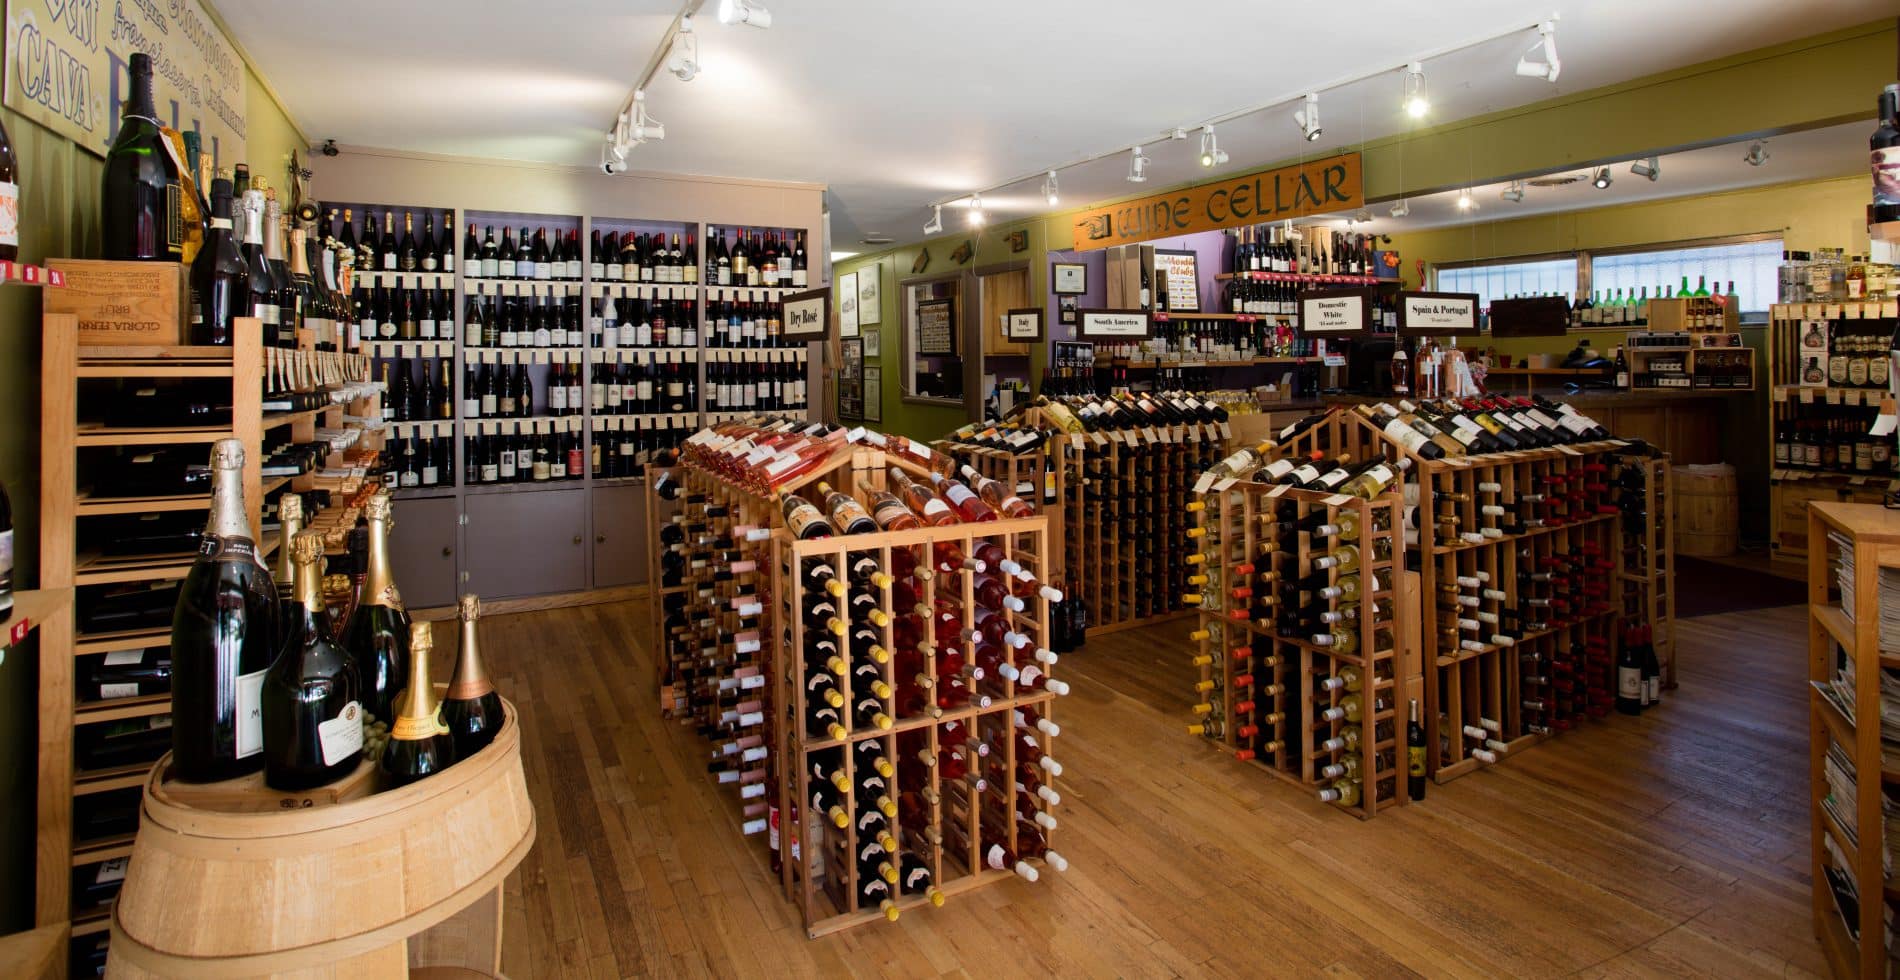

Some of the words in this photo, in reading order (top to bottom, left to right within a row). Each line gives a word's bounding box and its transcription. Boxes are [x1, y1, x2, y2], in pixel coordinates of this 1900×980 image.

[17, 23, 94, 132] CAVA
[1117, 197, 1191, 238] WINE
[1206, 164, 1353, 223] CELLAR
[98, 304, 130, 314] BRUT
[1318, 301, 1347, 309] Domestic
[1412, 304, 1431, 316] Spain
[1433, 305, 1439, 314] &
[1441, 304, 1468, 316] Portugal
[790, 311, 801, 328] Dry
[802, 308, 818, 324] Rosé
[1018, 318, 1029, 327] Italy
[79, 321, 110, 331] FERR
[113, 321, 160, 331] GLORIA
